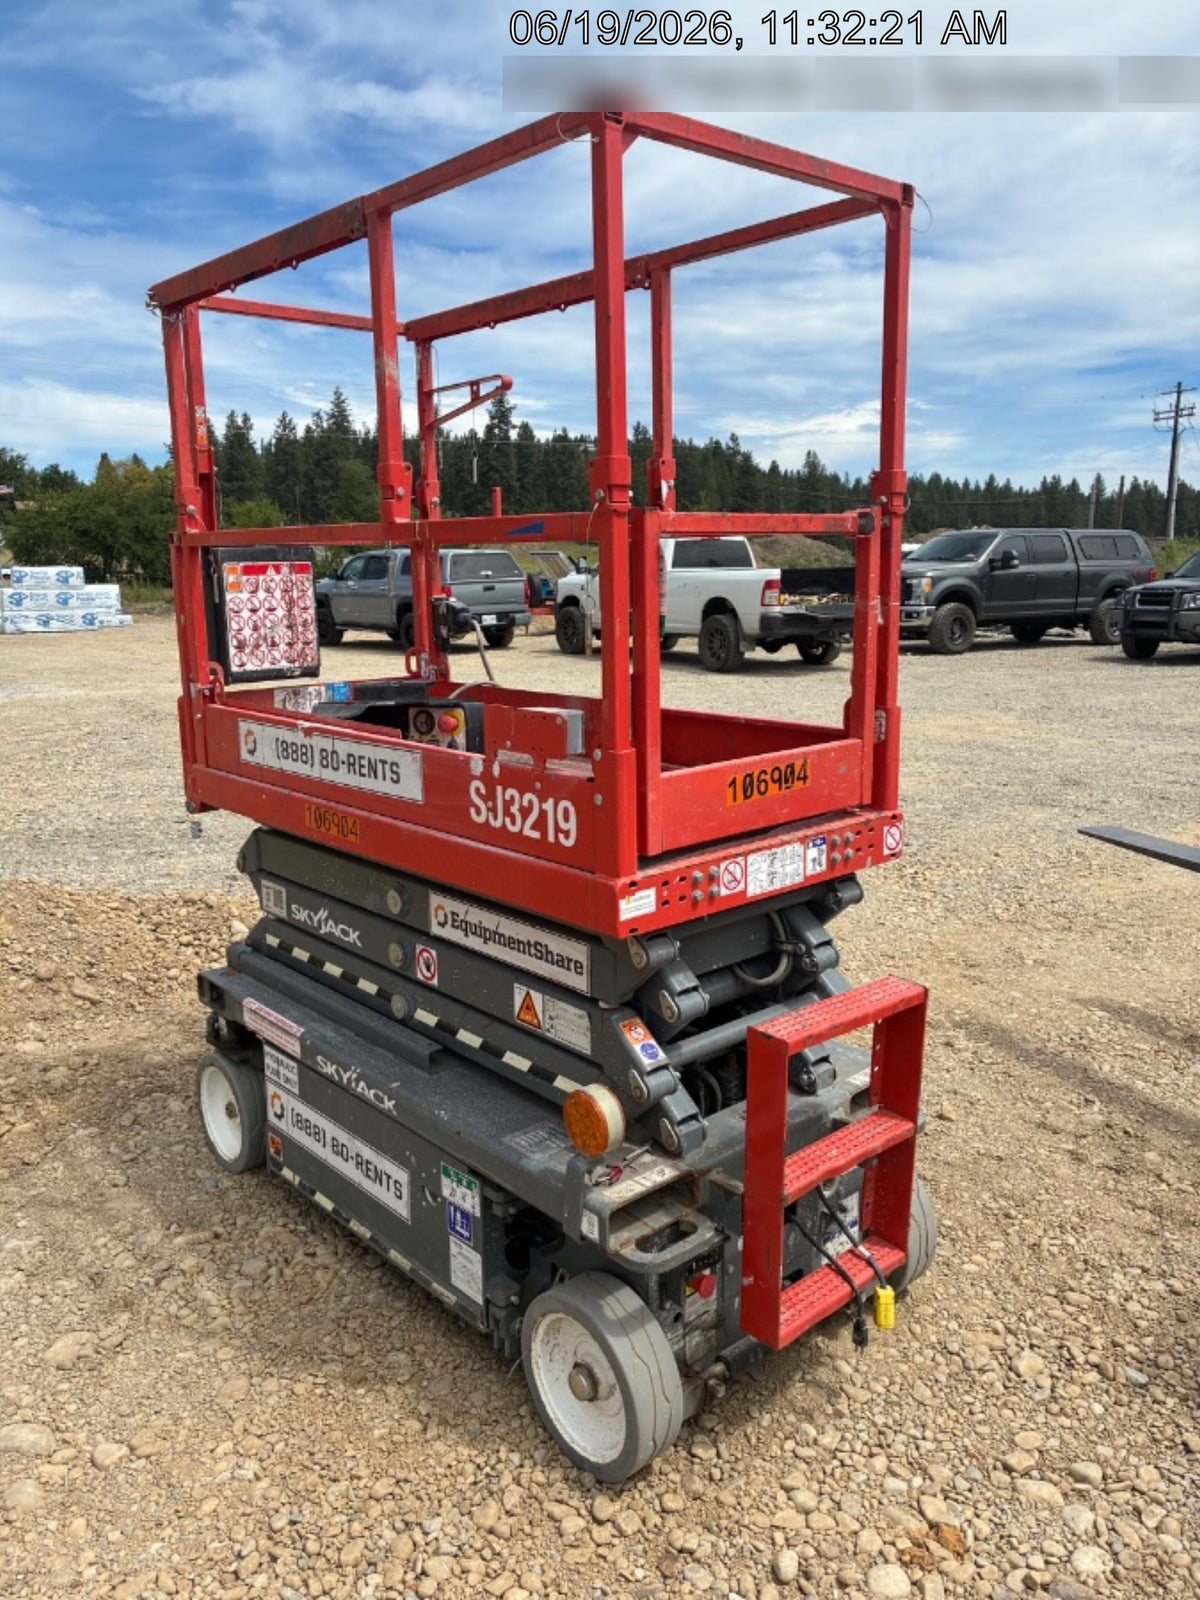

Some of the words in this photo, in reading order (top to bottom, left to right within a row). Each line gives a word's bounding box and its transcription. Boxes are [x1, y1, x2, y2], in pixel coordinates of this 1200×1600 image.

[275, 737, 315, 768] (888)
[319, 748, 401, 785] 80-RENTS
[728, 759, 809, 803] 106904
[306, 806, 360, 839] 106904
[468, 779, 578, 848] SJ3219
[290, 903, 363, 948] SKYJACK
[450, 910, 586, 977] EquipmentShare
[290, 1107, 327, 1149] (888)
